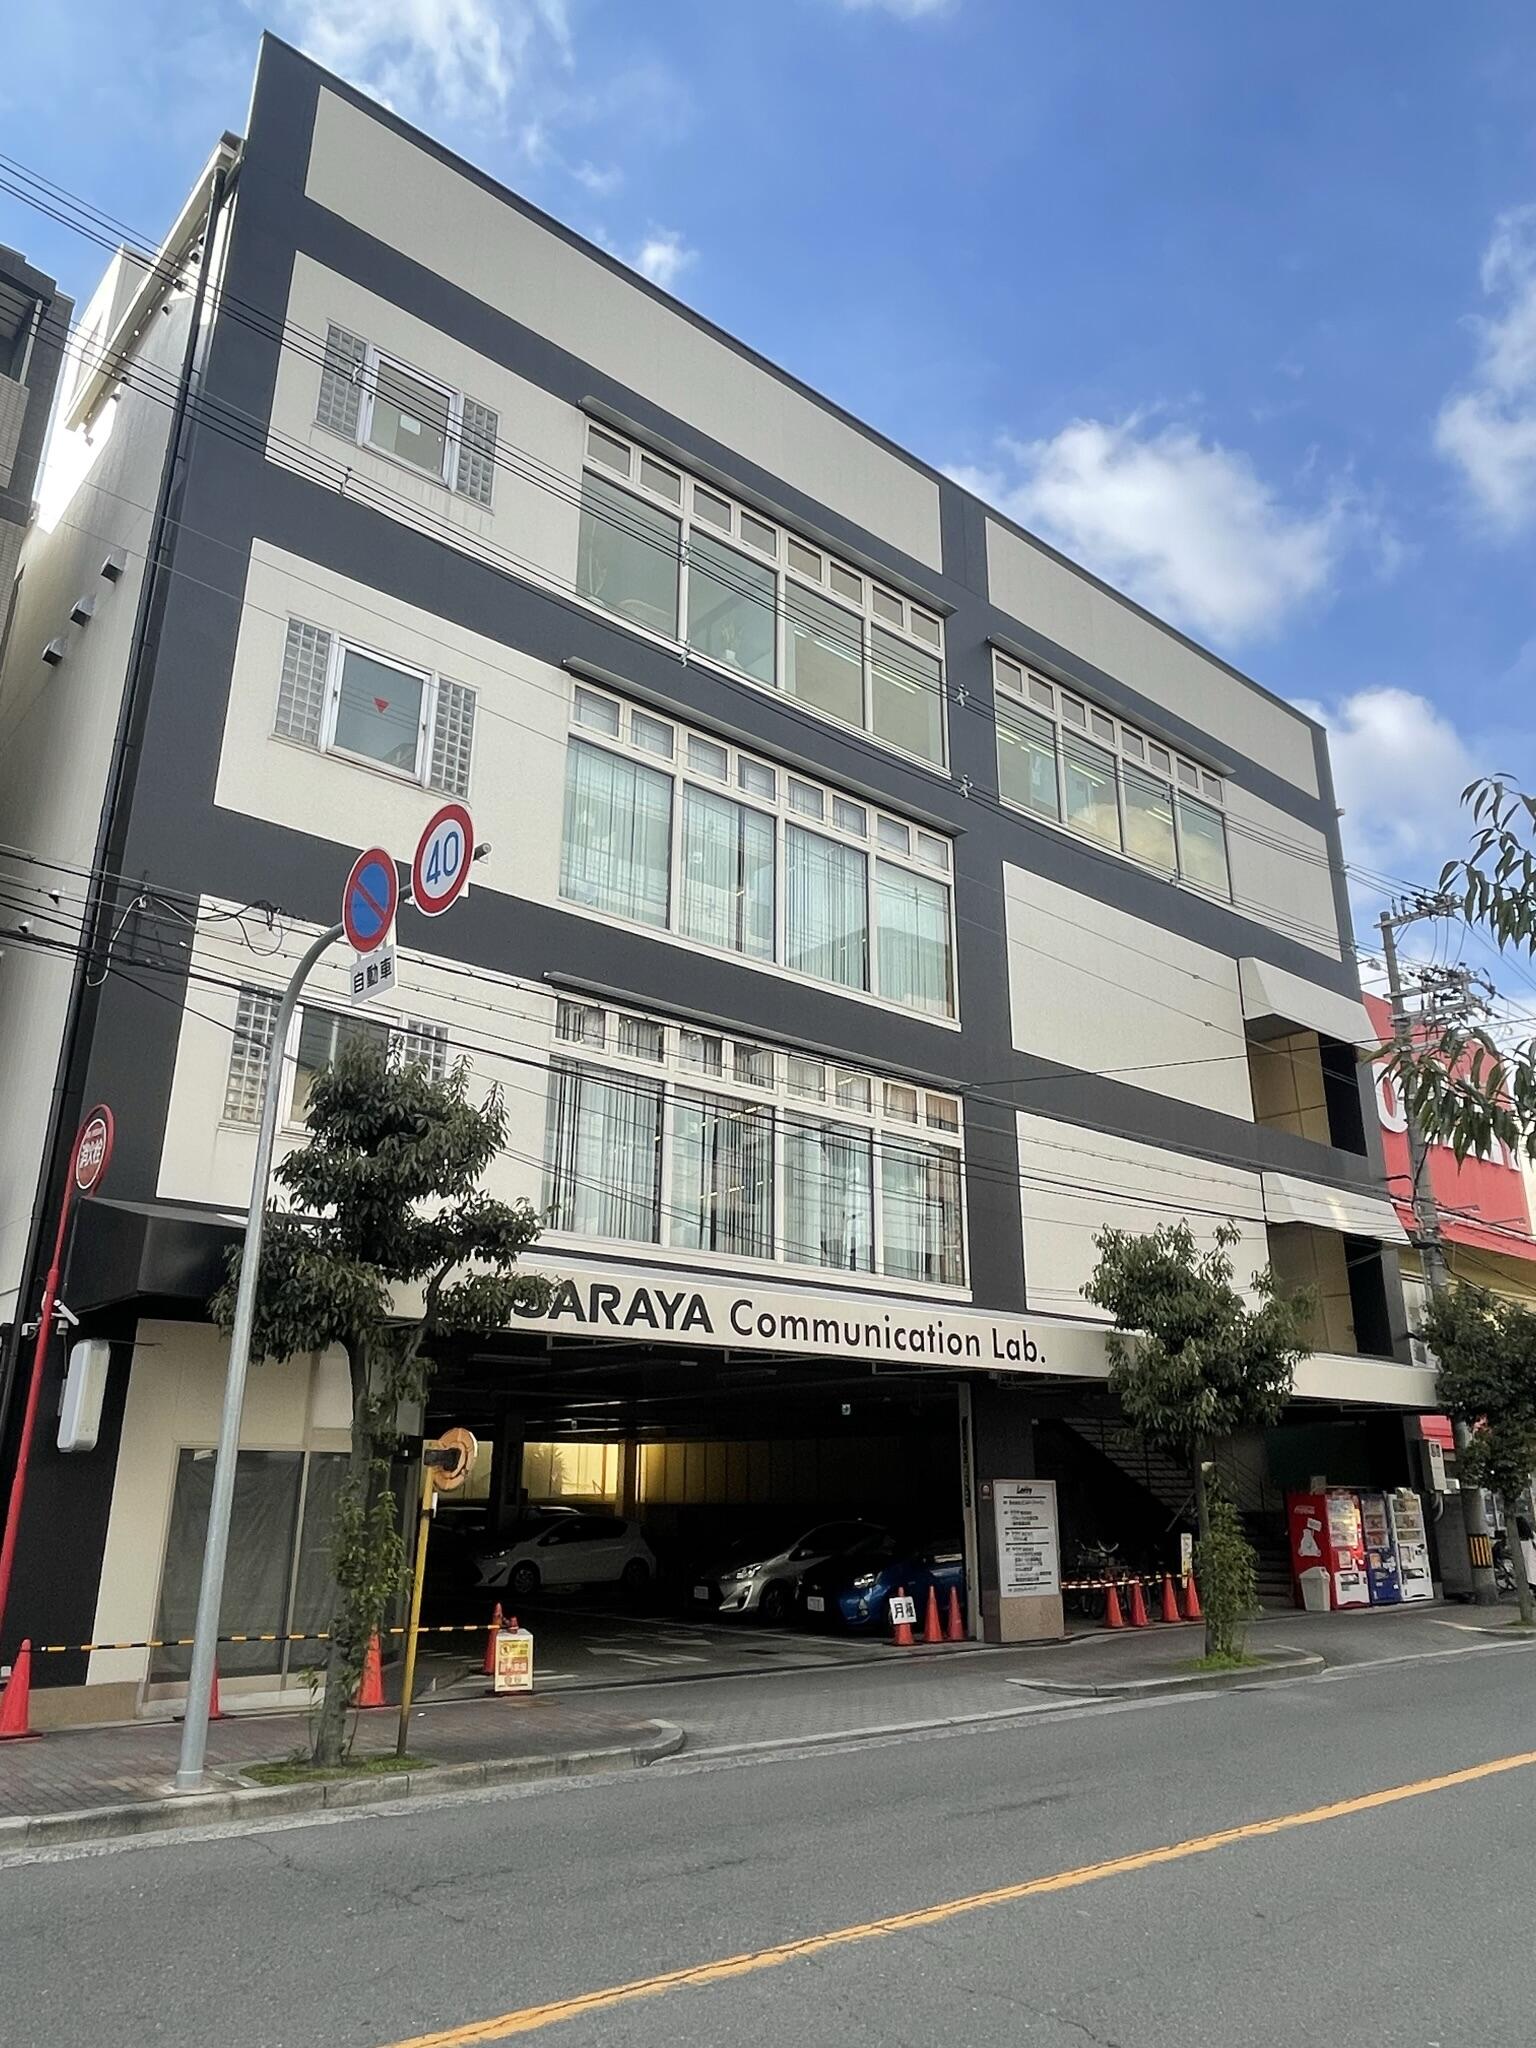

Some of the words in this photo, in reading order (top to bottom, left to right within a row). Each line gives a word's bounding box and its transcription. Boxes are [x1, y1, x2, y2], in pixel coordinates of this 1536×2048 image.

[426, 831, 460, 885] 40
[354, 957, 393, 994] 自動車
[730, 1299, 981, 1357] Communication
[992, 1328, 1046, 1364] Lab.
